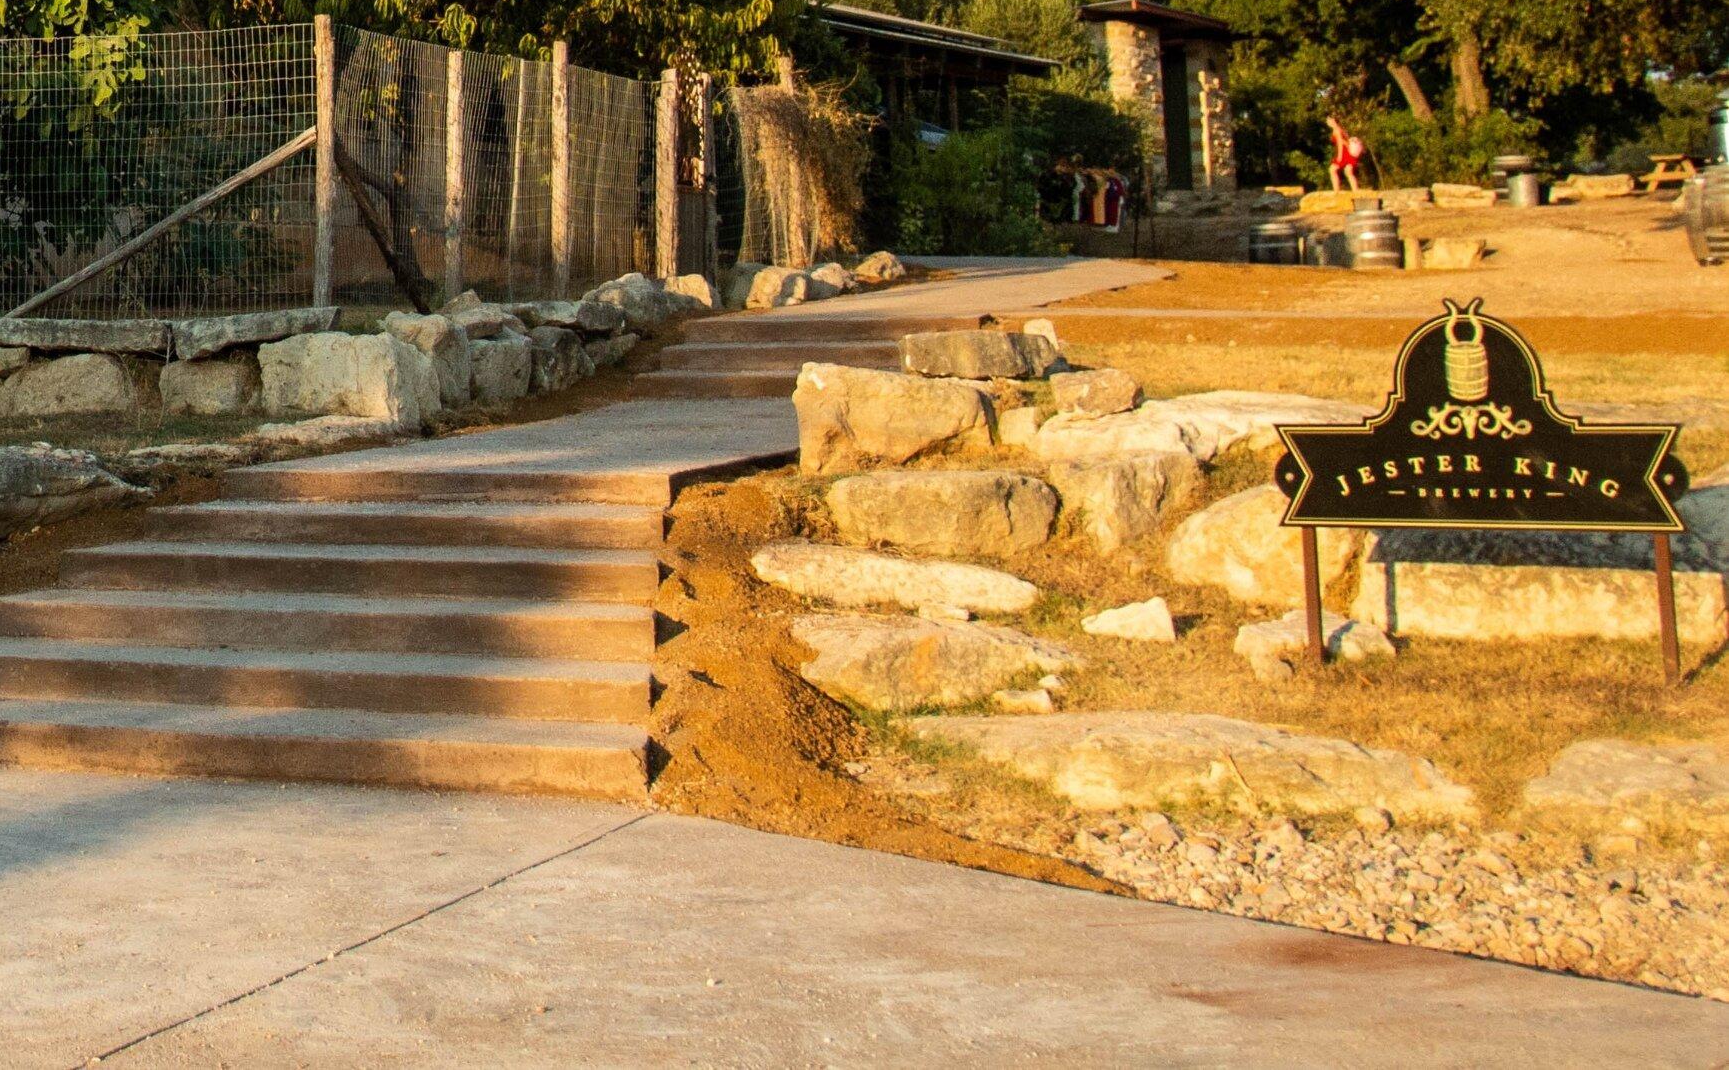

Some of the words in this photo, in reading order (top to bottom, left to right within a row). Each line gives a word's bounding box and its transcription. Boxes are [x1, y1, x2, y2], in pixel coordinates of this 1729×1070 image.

[1336, 454, 1482, 496] JESTER
[1513, 456, 1620, 498] KING
[1418, 487, 1533, 498] BREWERY
